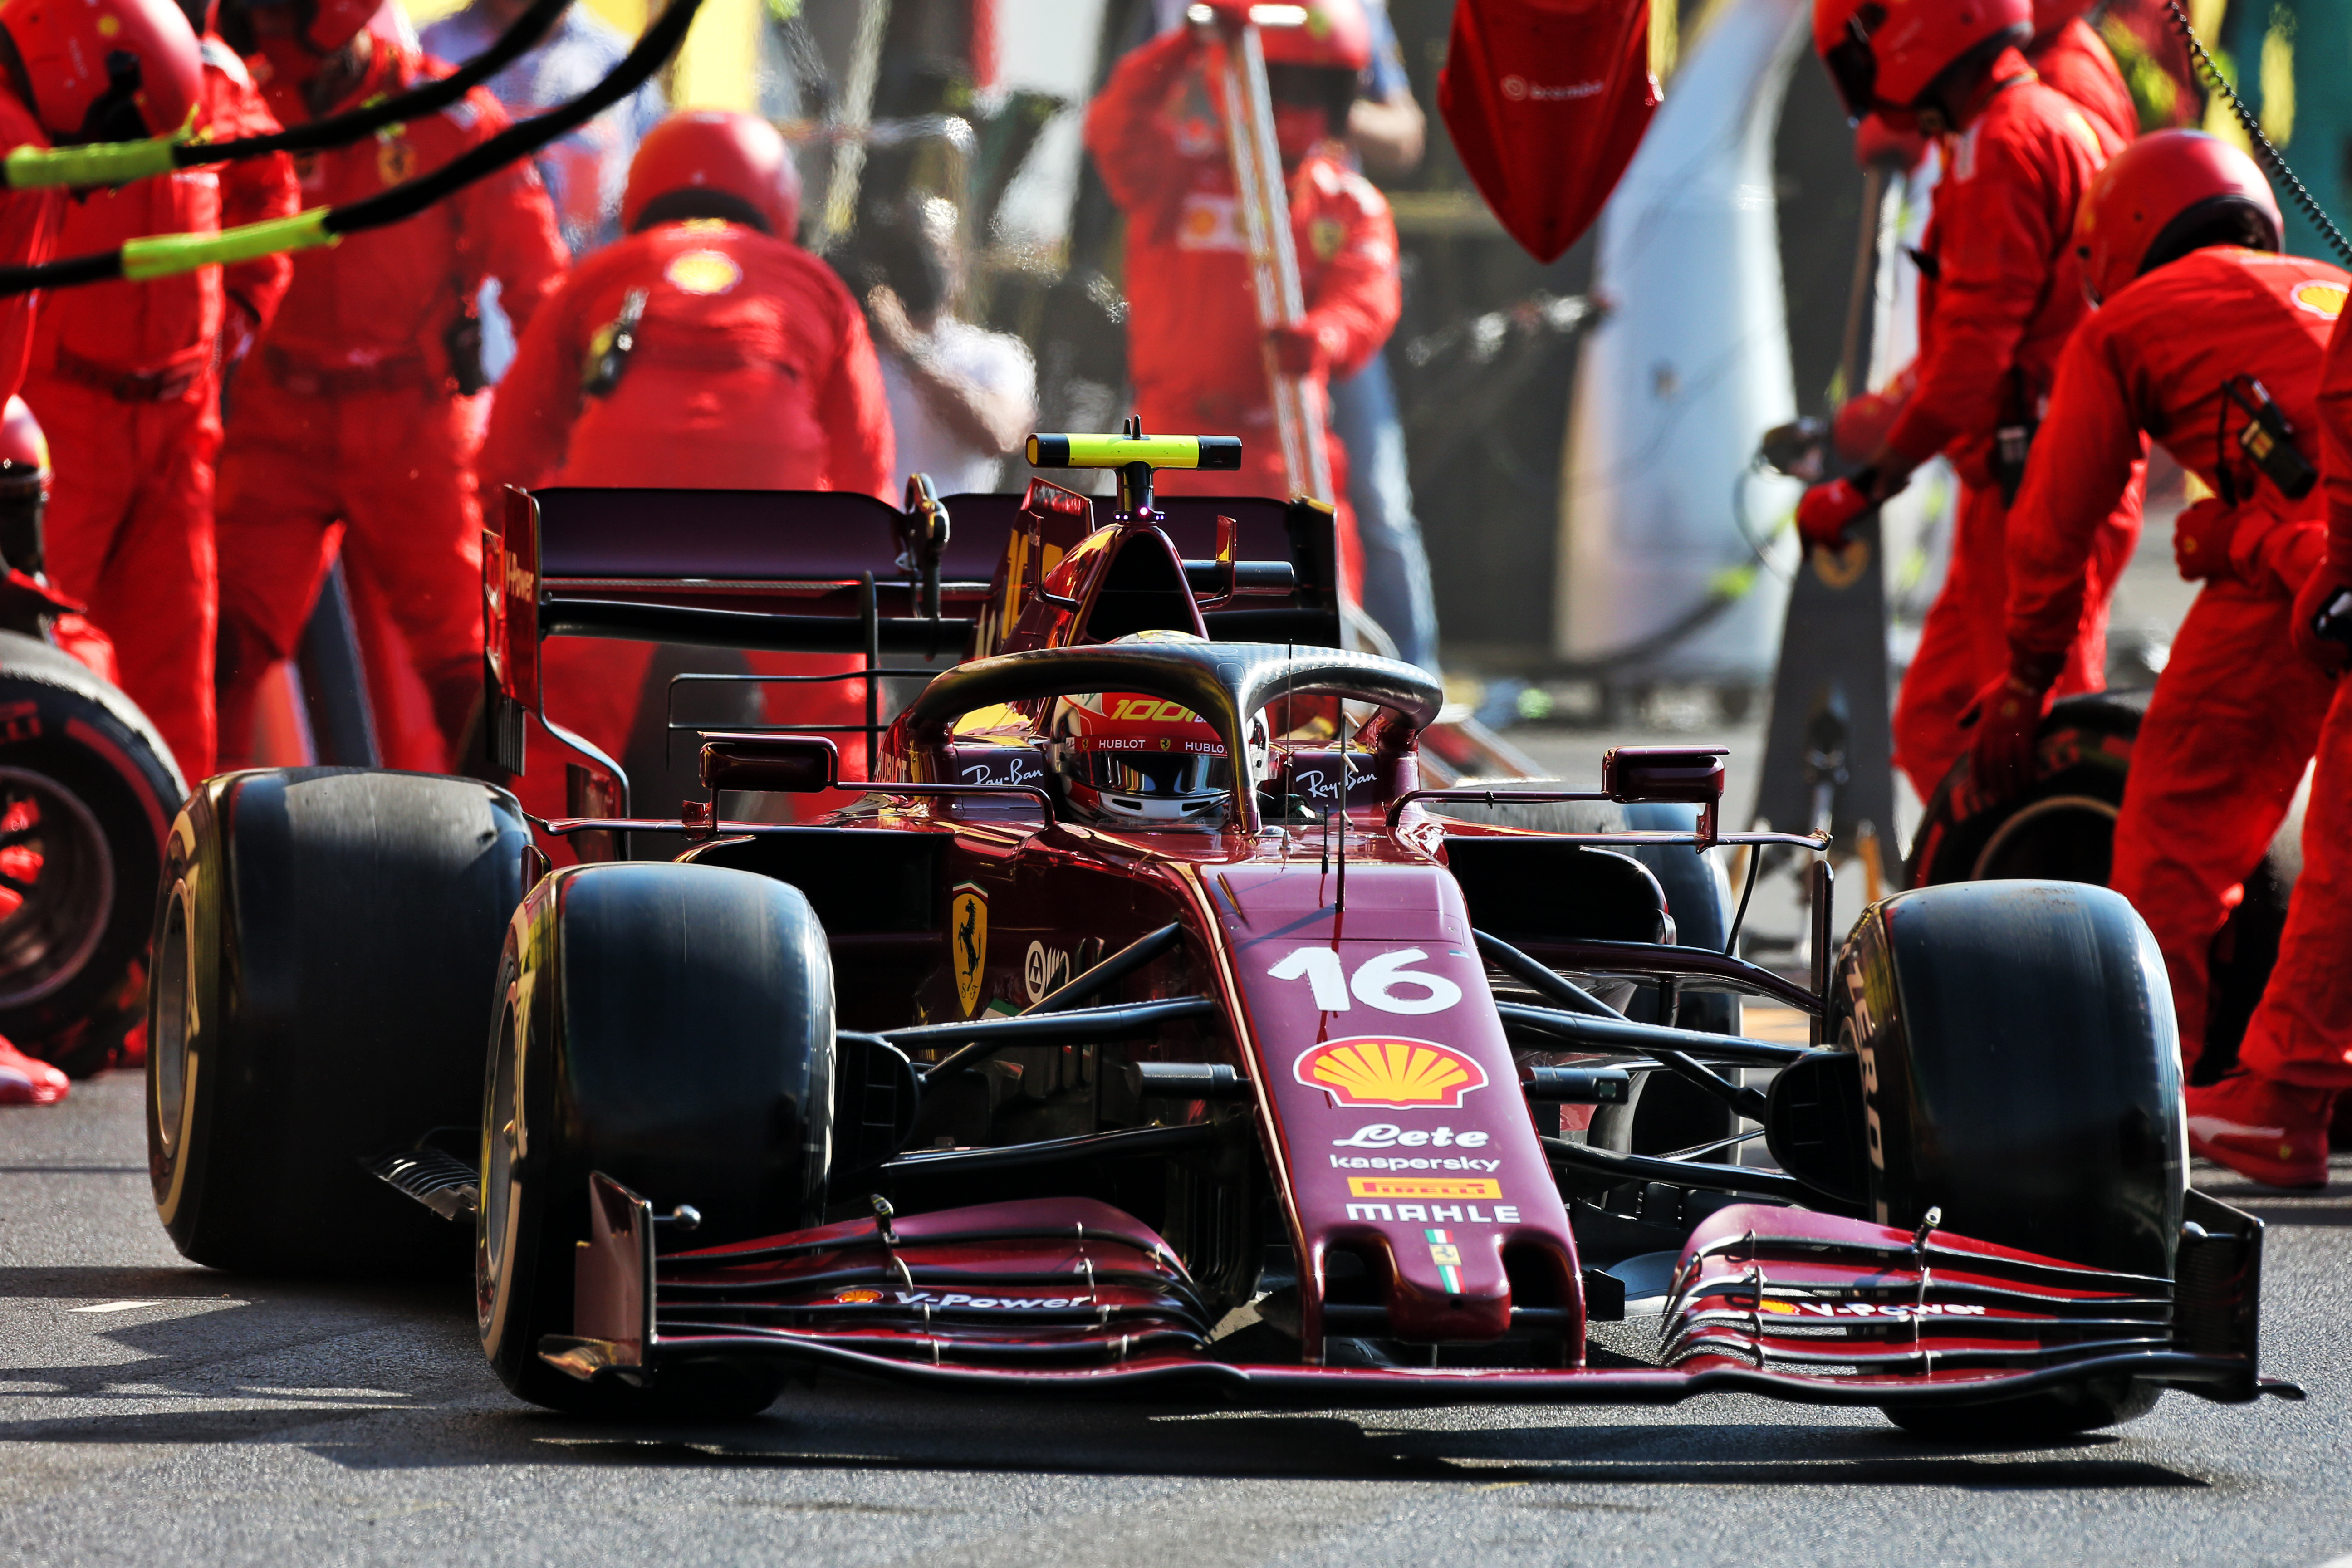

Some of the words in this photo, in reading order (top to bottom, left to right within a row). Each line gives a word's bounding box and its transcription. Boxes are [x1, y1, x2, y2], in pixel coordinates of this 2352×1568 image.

[1099, 739, 1146, 749] HUBLOT
[1185, 742, 1228, 754] HUBLO
[1267, 946, 1462, 1015] 16
[1332, 1123, 1490, 1149] Lete
[1329, 1154, 1501, 1173] kaspersky
[1362, 1182, 1485, 1195] PIRELLI
[1345, 1203, 1521, 1224] MAHLE
[895, 1291, 1091, 1308] V-Power
